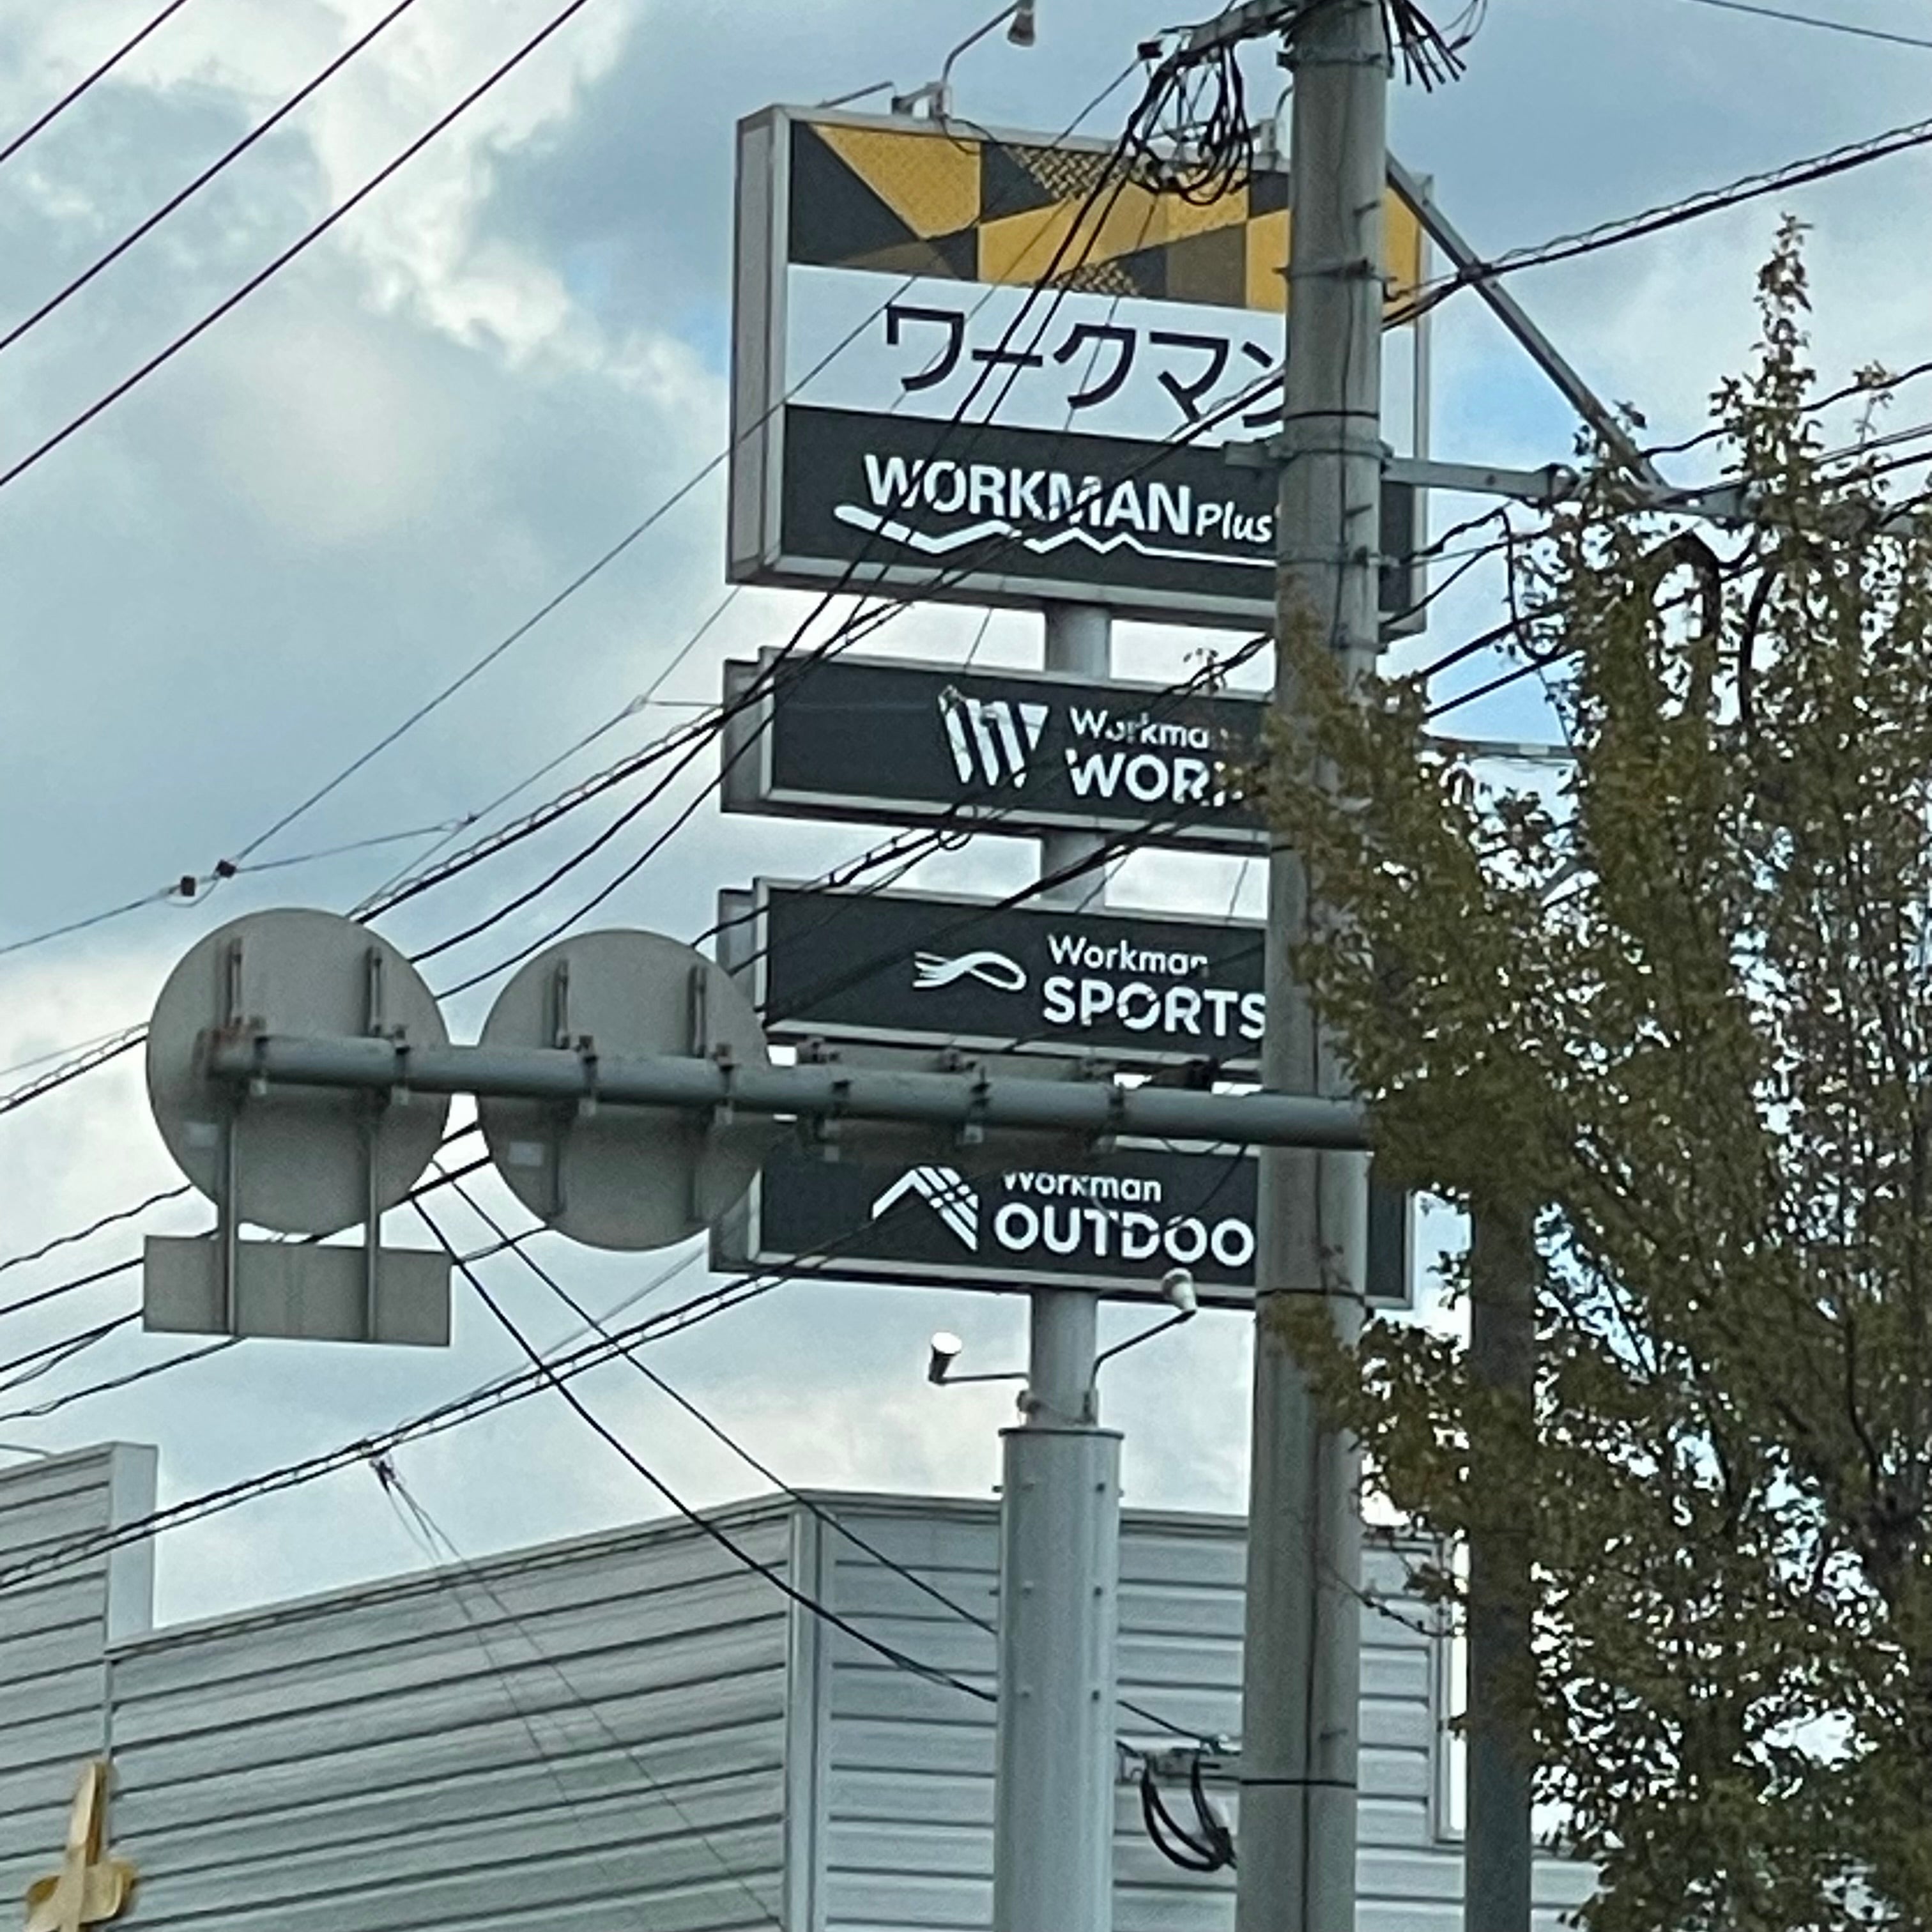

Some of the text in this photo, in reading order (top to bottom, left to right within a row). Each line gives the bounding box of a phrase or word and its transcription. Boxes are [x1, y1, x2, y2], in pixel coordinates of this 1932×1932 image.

[864, 454, 1273, 542] WORKMAN Plus
[1069, 706, 1228, 750] Workma
[1043, 976, 1267, 1039] SPORTS
